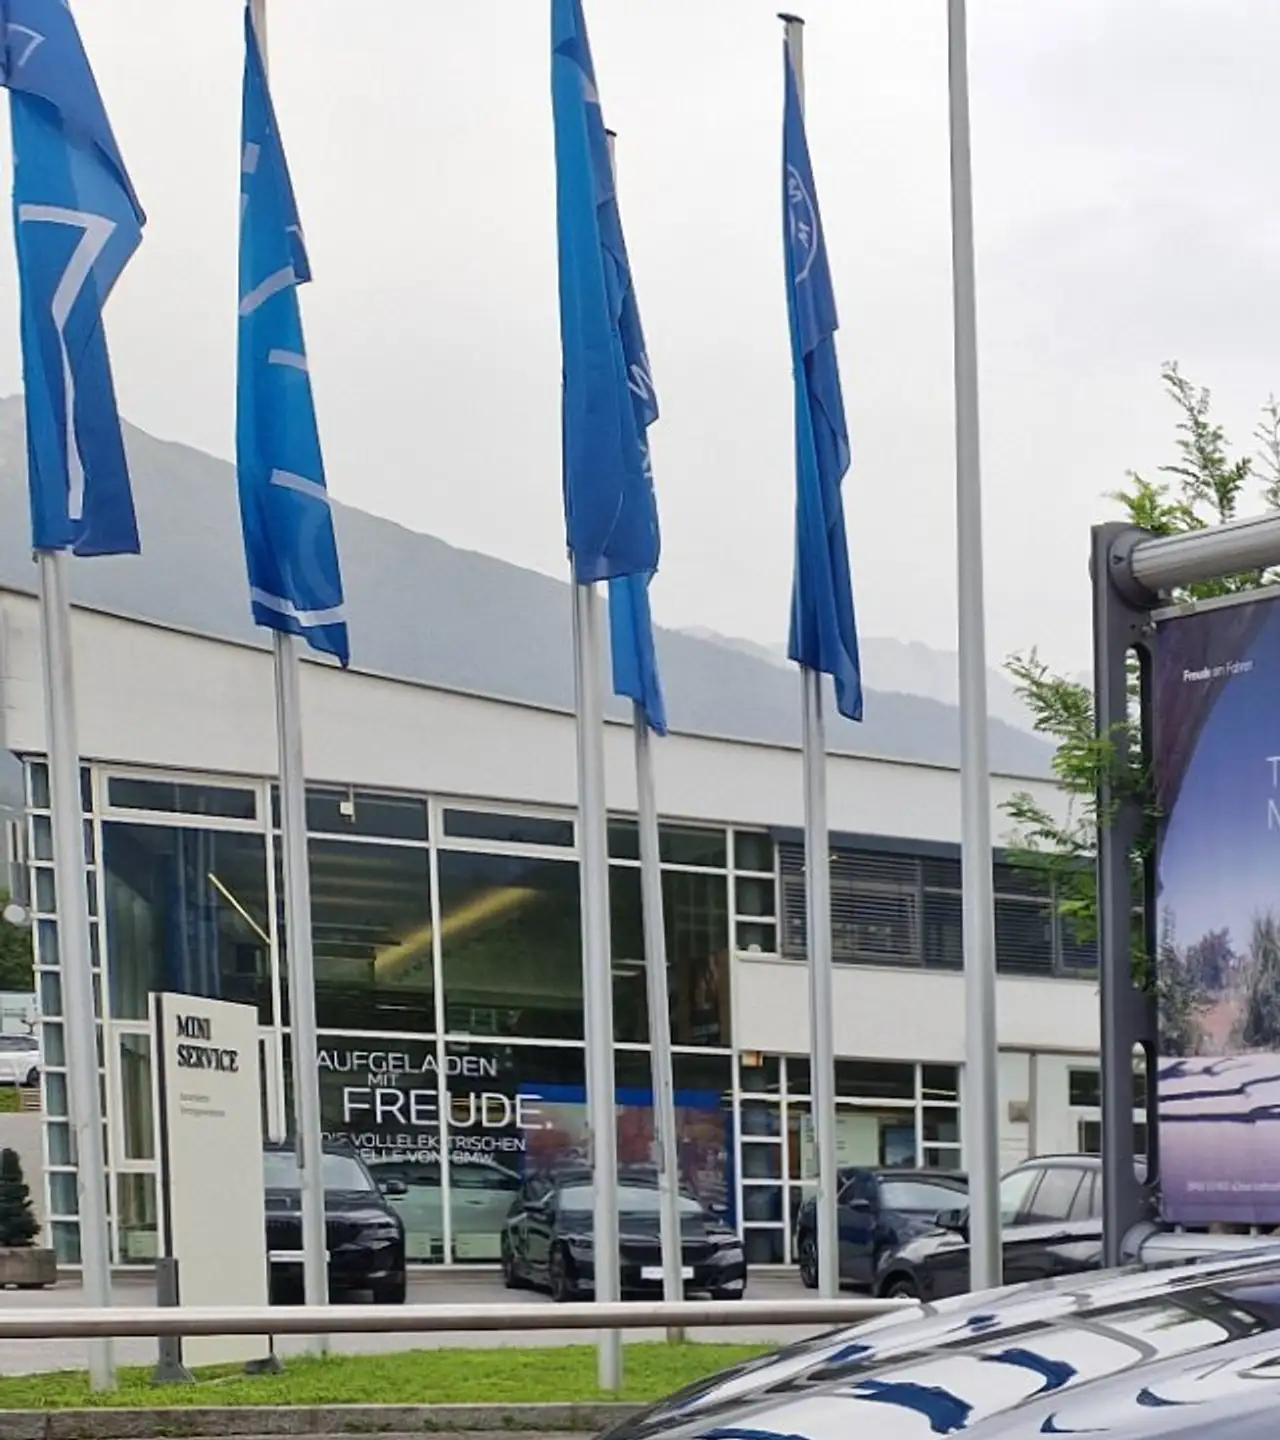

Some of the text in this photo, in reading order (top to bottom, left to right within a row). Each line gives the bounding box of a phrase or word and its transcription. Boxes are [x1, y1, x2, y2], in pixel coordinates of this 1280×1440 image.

[176, 1014, 211, 1040] MINI
[177, 1044, 239, 1072] SERVICE
[317, 1050, 497, 1077] AUFGELADEN
[367, 1073, 399, 1087] MIT
[343, 1087, 553, 1129] FREUDE.
